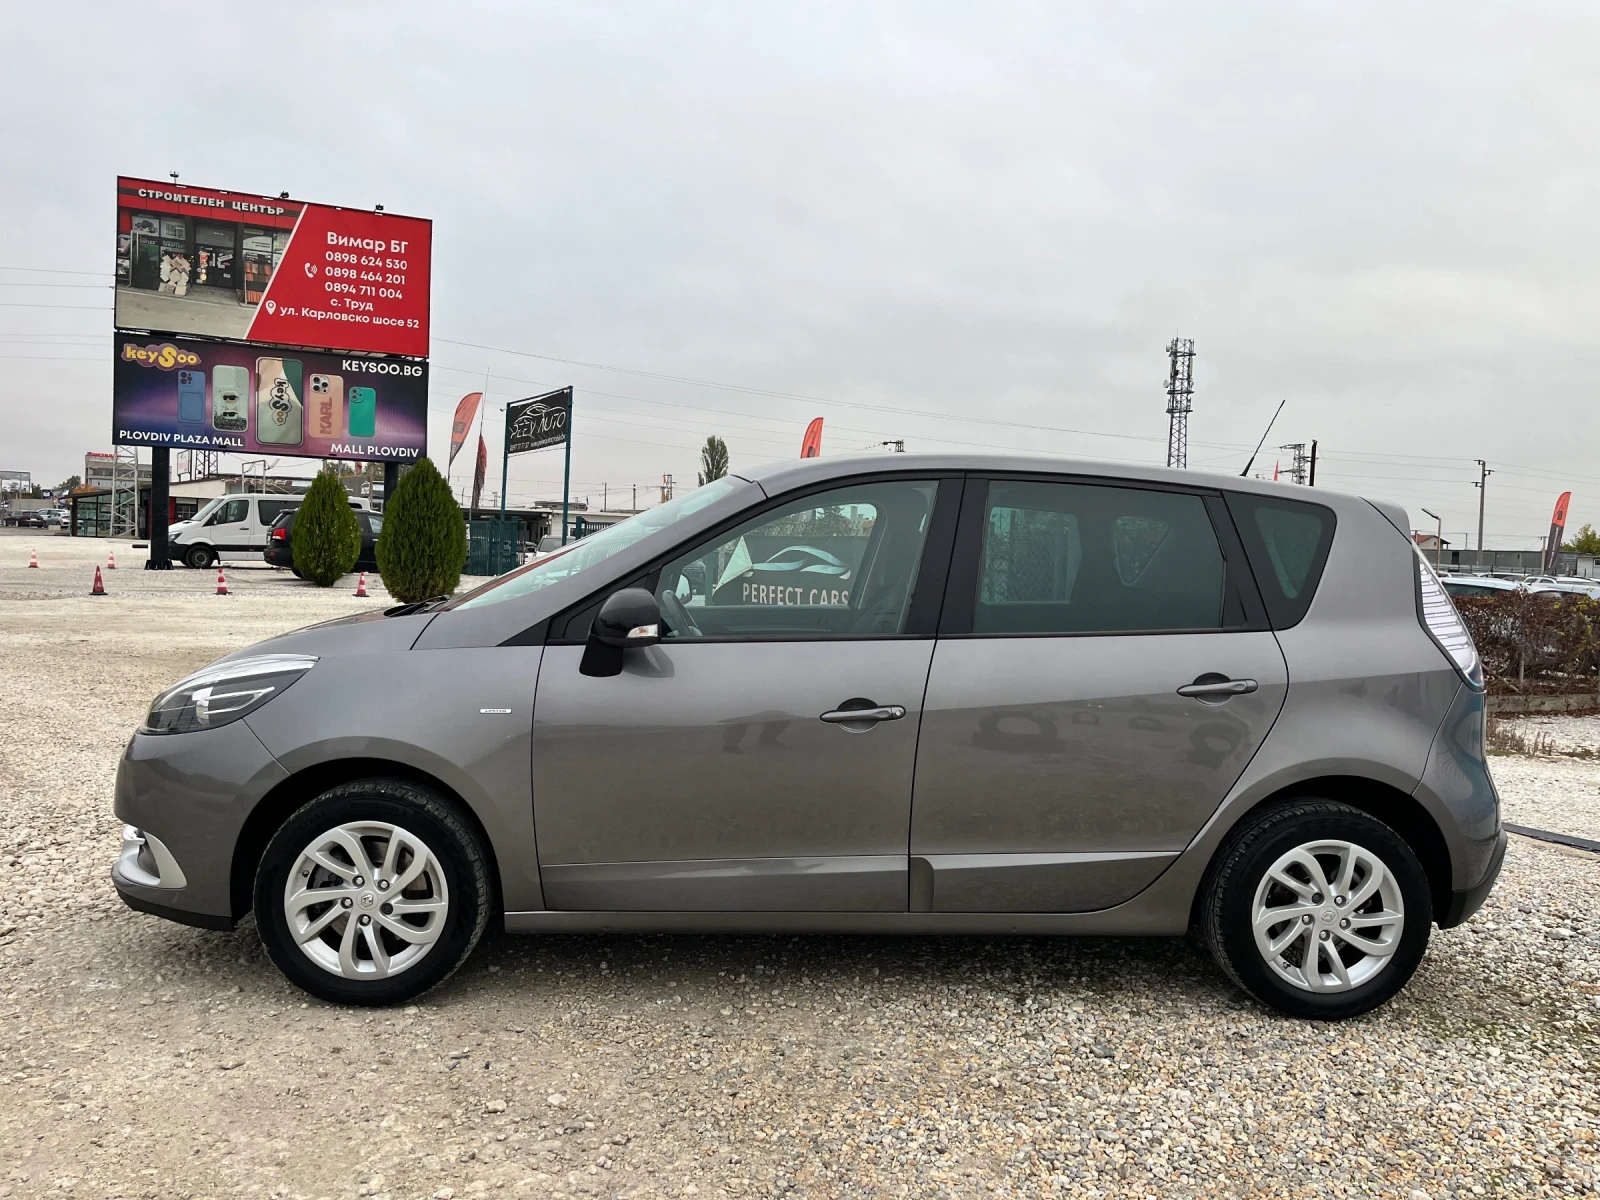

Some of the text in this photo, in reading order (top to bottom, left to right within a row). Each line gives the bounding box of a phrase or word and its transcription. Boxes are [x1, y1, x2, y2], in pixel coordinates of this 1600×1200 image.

[138, 188, 285, 216] СТРОИТЕЛЕН ЦЕНТЪР
[327, 231, 409, 254] Вимар БГ
[325, 251, 408, 270] 0898 624 530
[325, 266, 406, 285] 0898 464 201
[324, 281, 403, 300] 0894 711 004
[330, 298, 374, 312] с. Труд
[280, 306, 420, 328] ул. Карловско шосе 52
[342, 359, 423, 377] KEYSOO.BG
[319, 397, 333, 435] KARL
[119, 430, 244, 447] PLOVDIV PLAZA MALL
[330, 443, 419, 458] MALL PLOVDIV
[742, 583, 849, 606] PERFECT CARS
